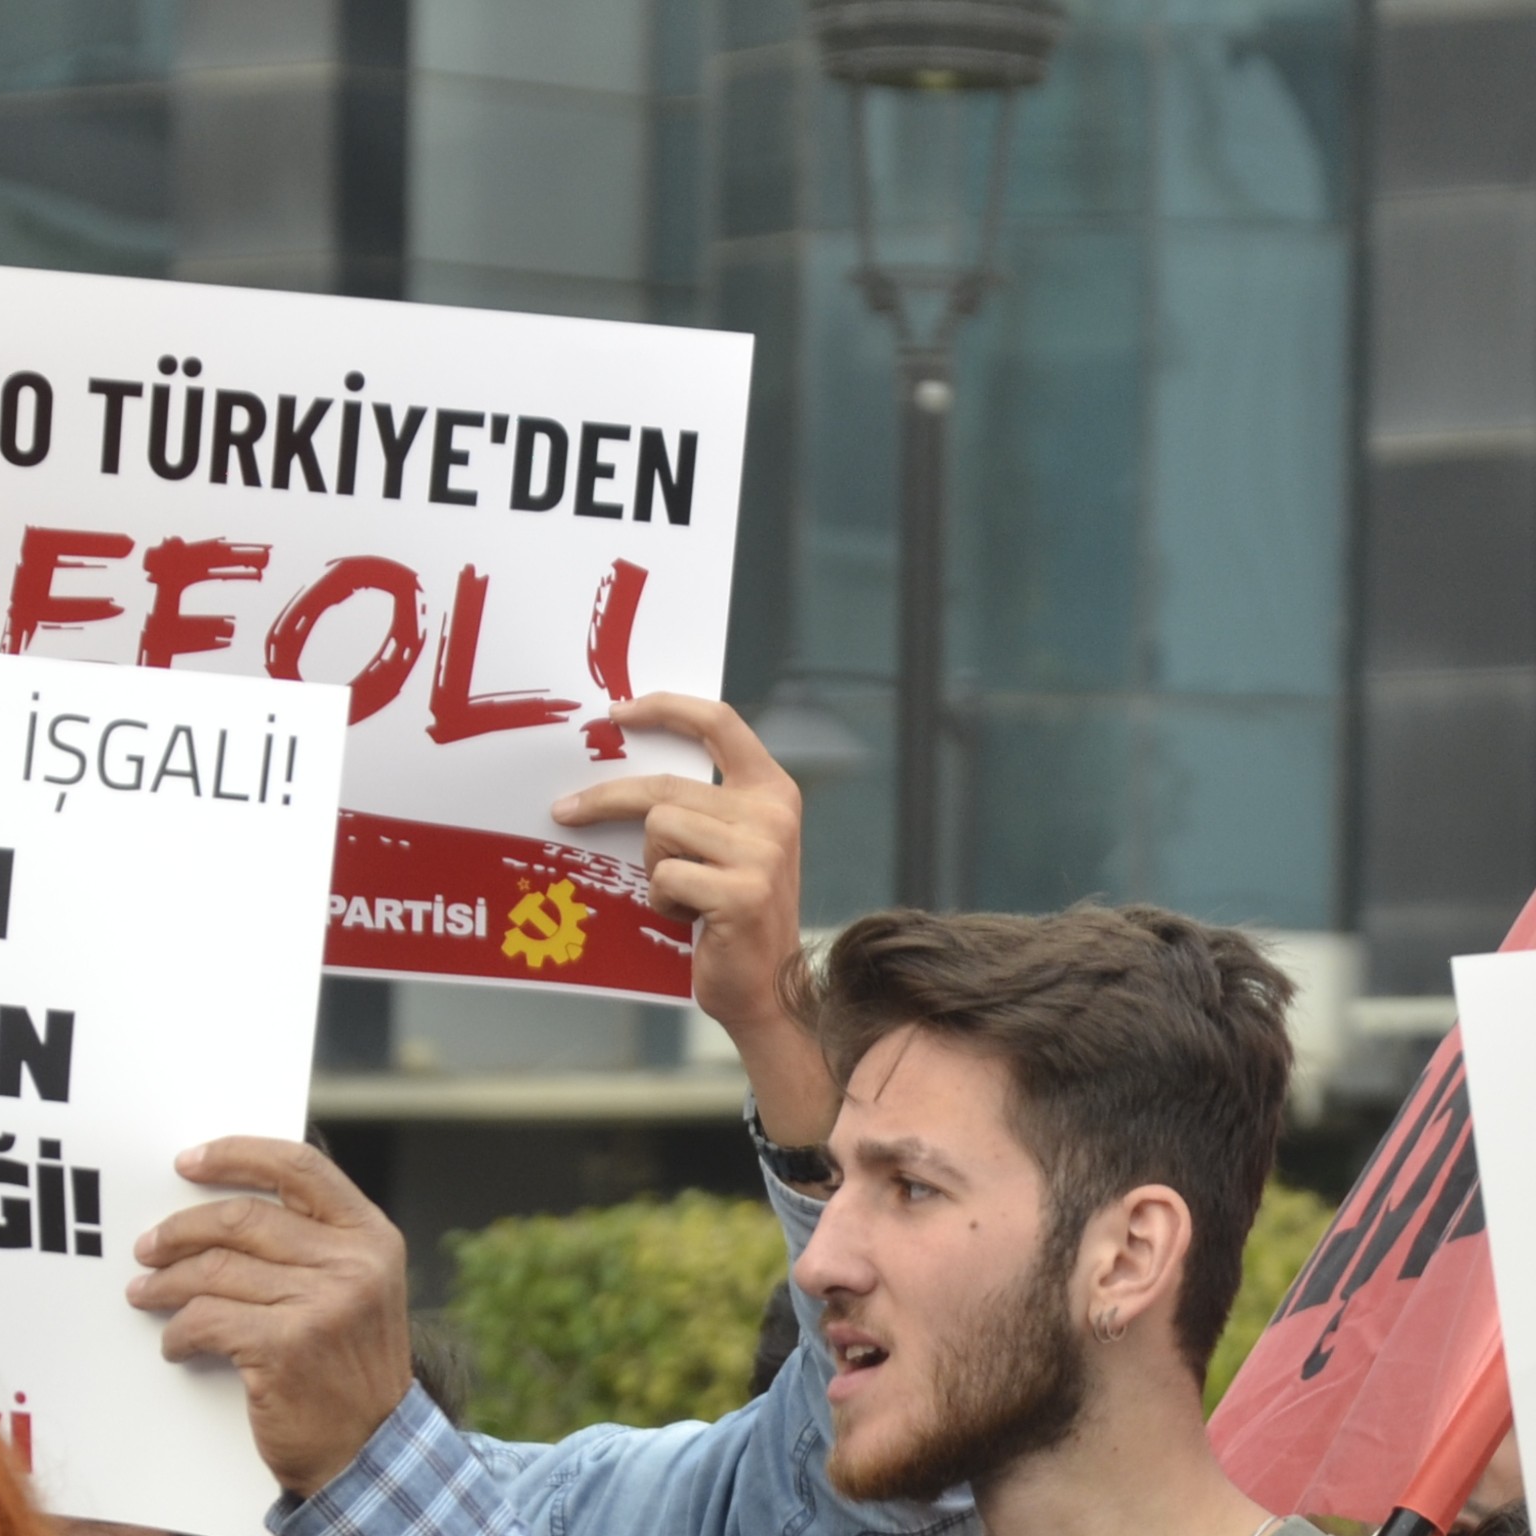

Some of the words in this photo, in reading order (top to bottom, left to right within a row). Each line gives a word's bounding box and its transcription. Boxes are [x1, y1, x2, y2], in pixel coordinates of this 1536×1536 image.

[86, 353, 700, 528] TÜRKİYE'DEN
[23, 690, 300, 813] İŞGALİ!
[327, 894, 487, 937] PARTİSİ
